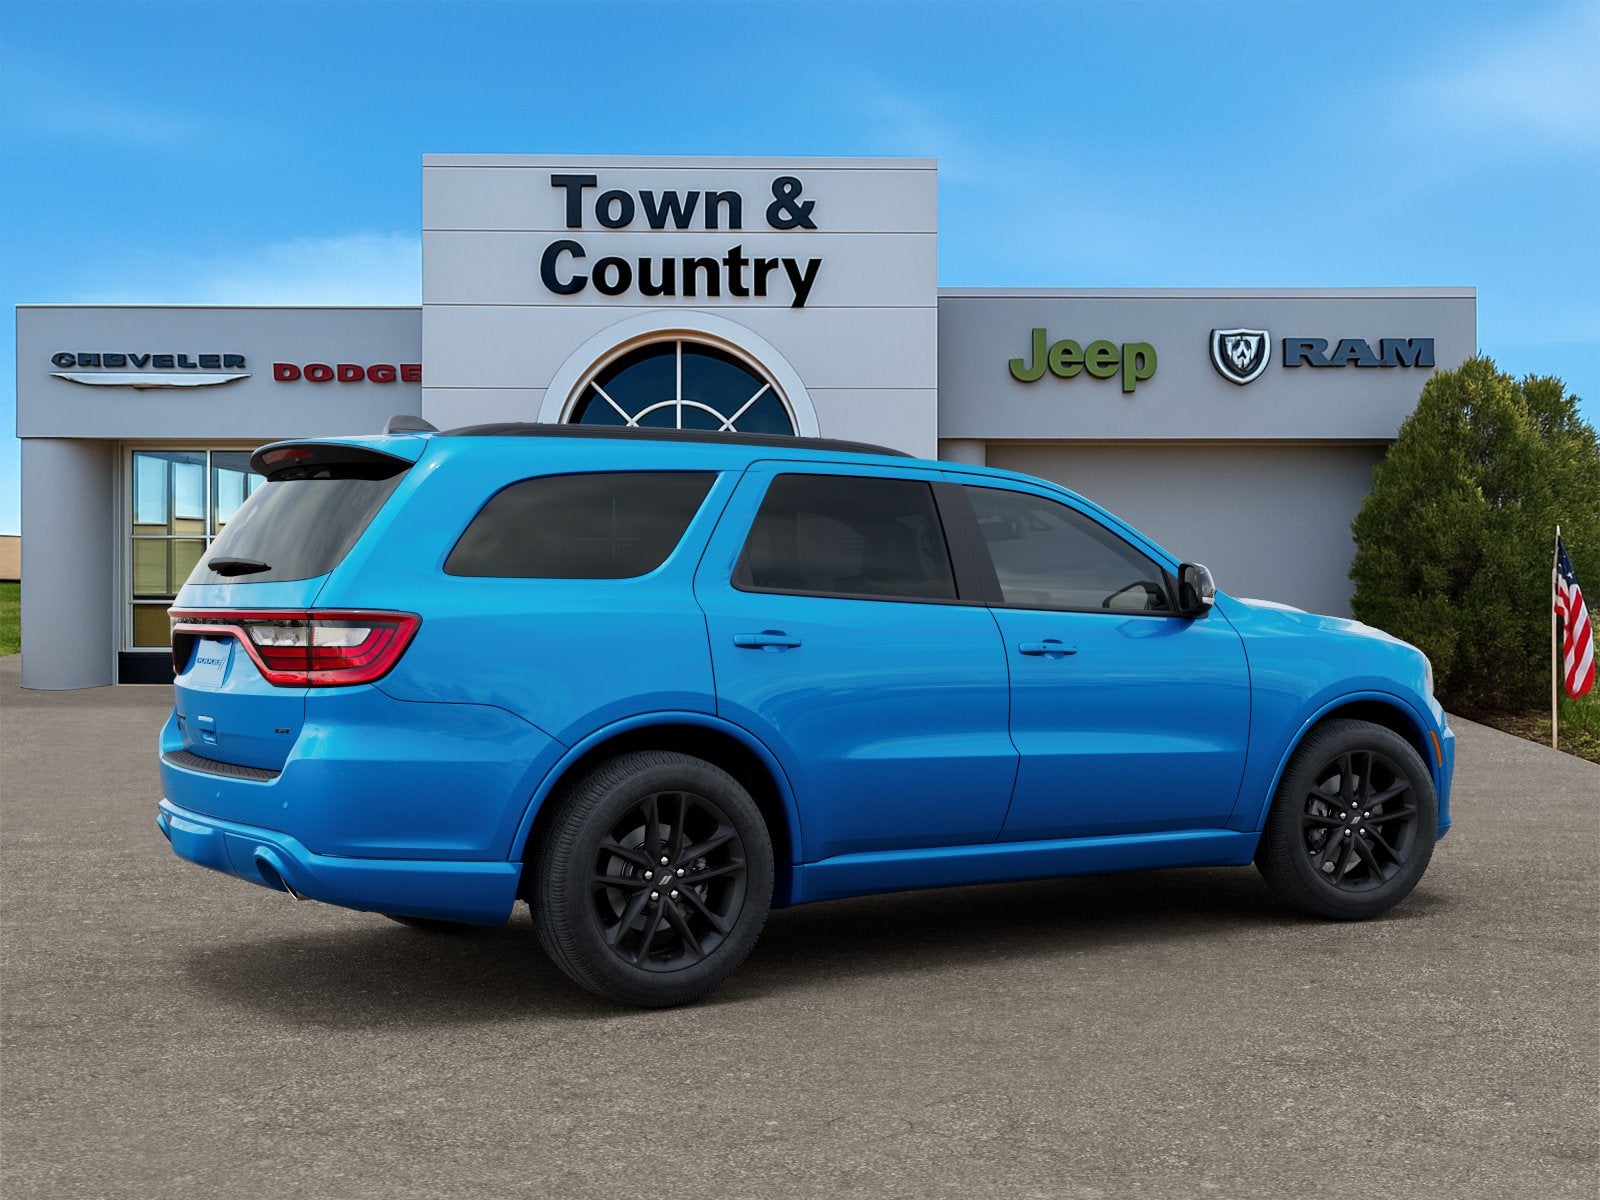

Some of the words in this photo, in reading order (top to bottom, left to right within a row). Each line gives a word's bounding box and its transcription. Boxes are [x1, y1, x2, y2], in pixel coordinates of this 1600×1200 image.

[550, 174, 742, 230] Town
[765, 175, 818, 230] &
[540, 239, 822, 308] Country
[272, 362, 422, 383] DODGE
[1009, 328, 1158, 393] Jeep
[1282, 337, 1435, 368] RAM
